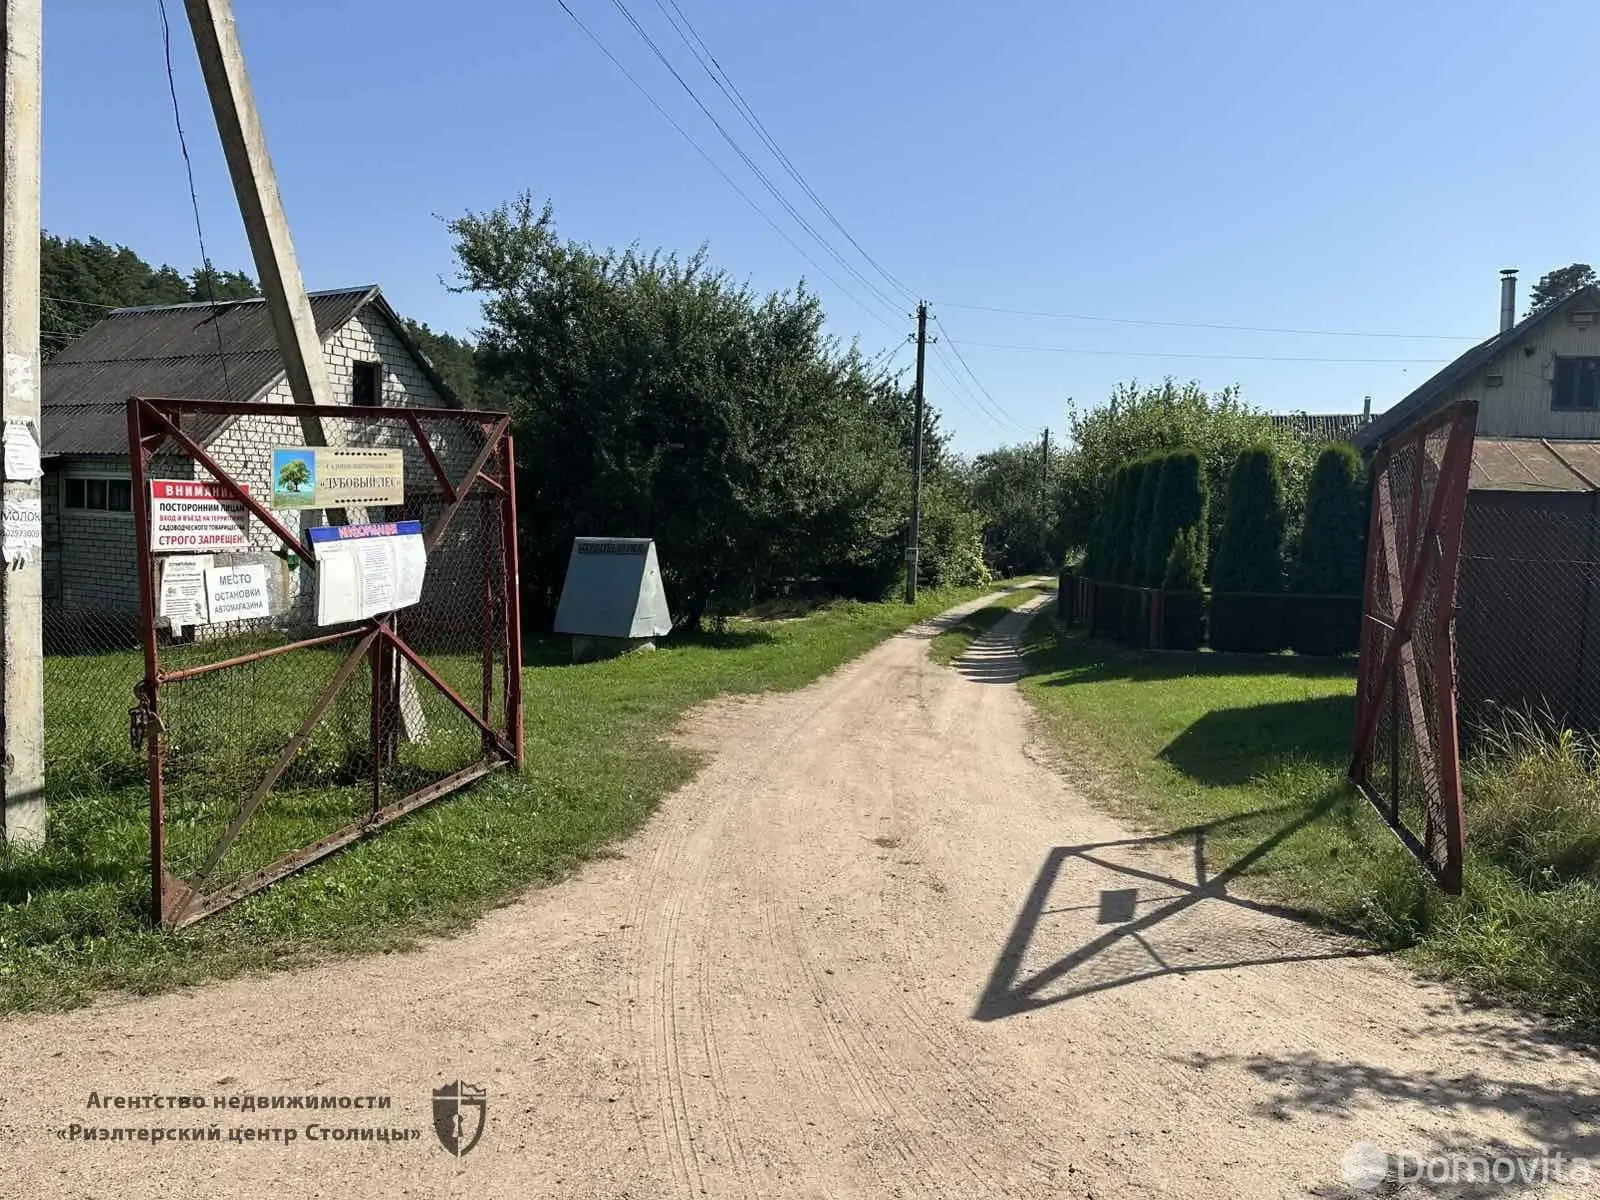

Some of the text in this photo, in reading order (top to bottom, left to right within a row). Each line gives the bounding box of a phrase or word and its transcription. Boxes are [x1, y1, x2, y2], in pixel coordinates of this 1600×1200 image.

[159, 502, 219, 512] ПОСТОРОННИМ
[158, 535, 197, 546] СТРОГО
[219, 573, 252, 586] МЕСТО
[214, 588, 261, 602] ОСТАНОВКИ
[214, 601, 264, 614] АВТОМАГАЗИНА
